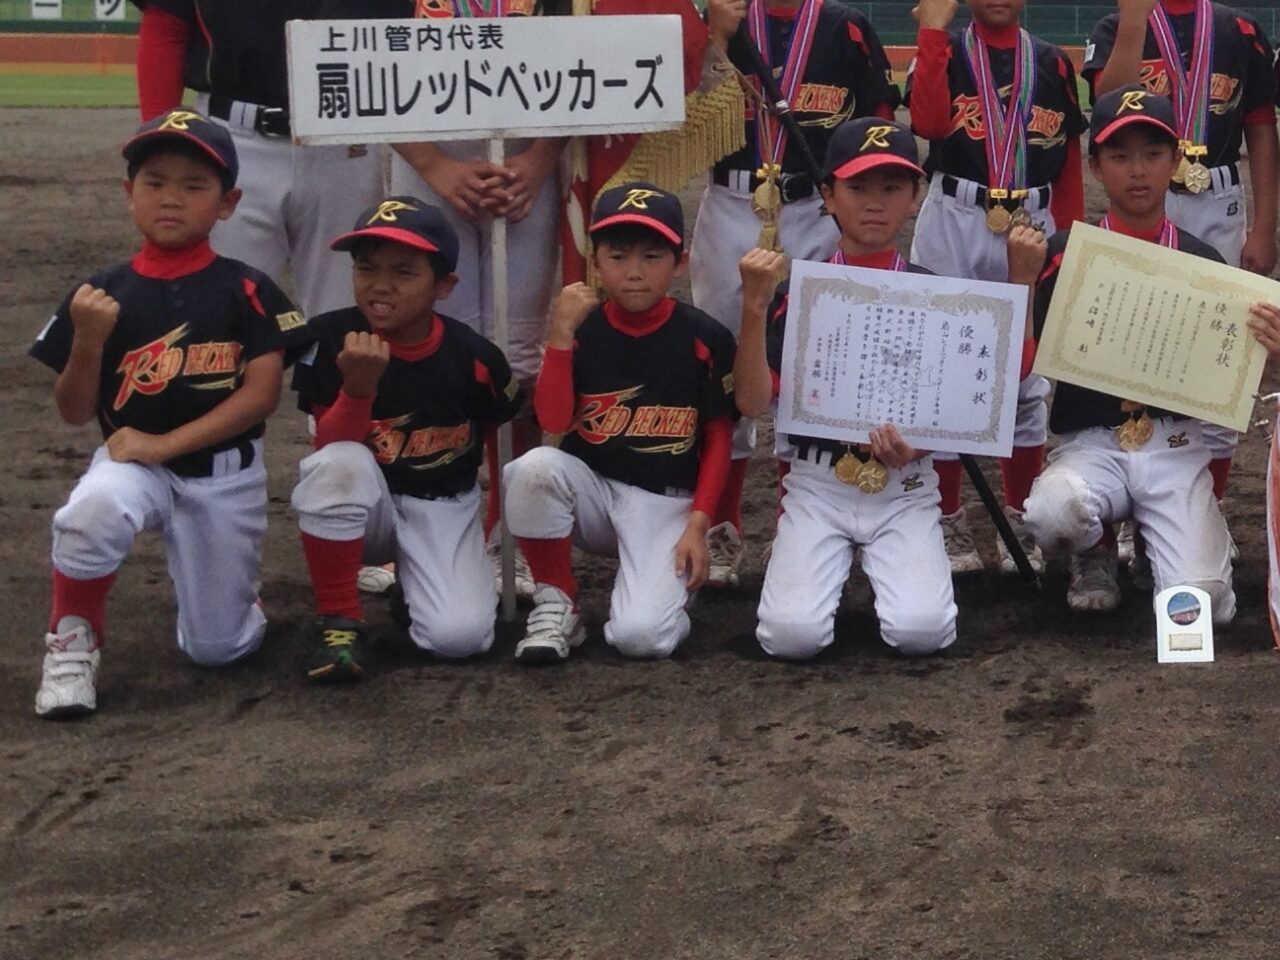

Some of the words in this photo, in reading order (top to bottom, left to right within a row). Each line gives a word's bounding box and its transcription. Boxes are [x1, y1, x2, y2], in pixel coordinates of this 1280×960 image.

[320, 24, 504, 52] 上川管内代表
[316, 54, 664, 119] 扇山レッドペッカーズ
[1215, 322, 1238, 368] 表彰状
